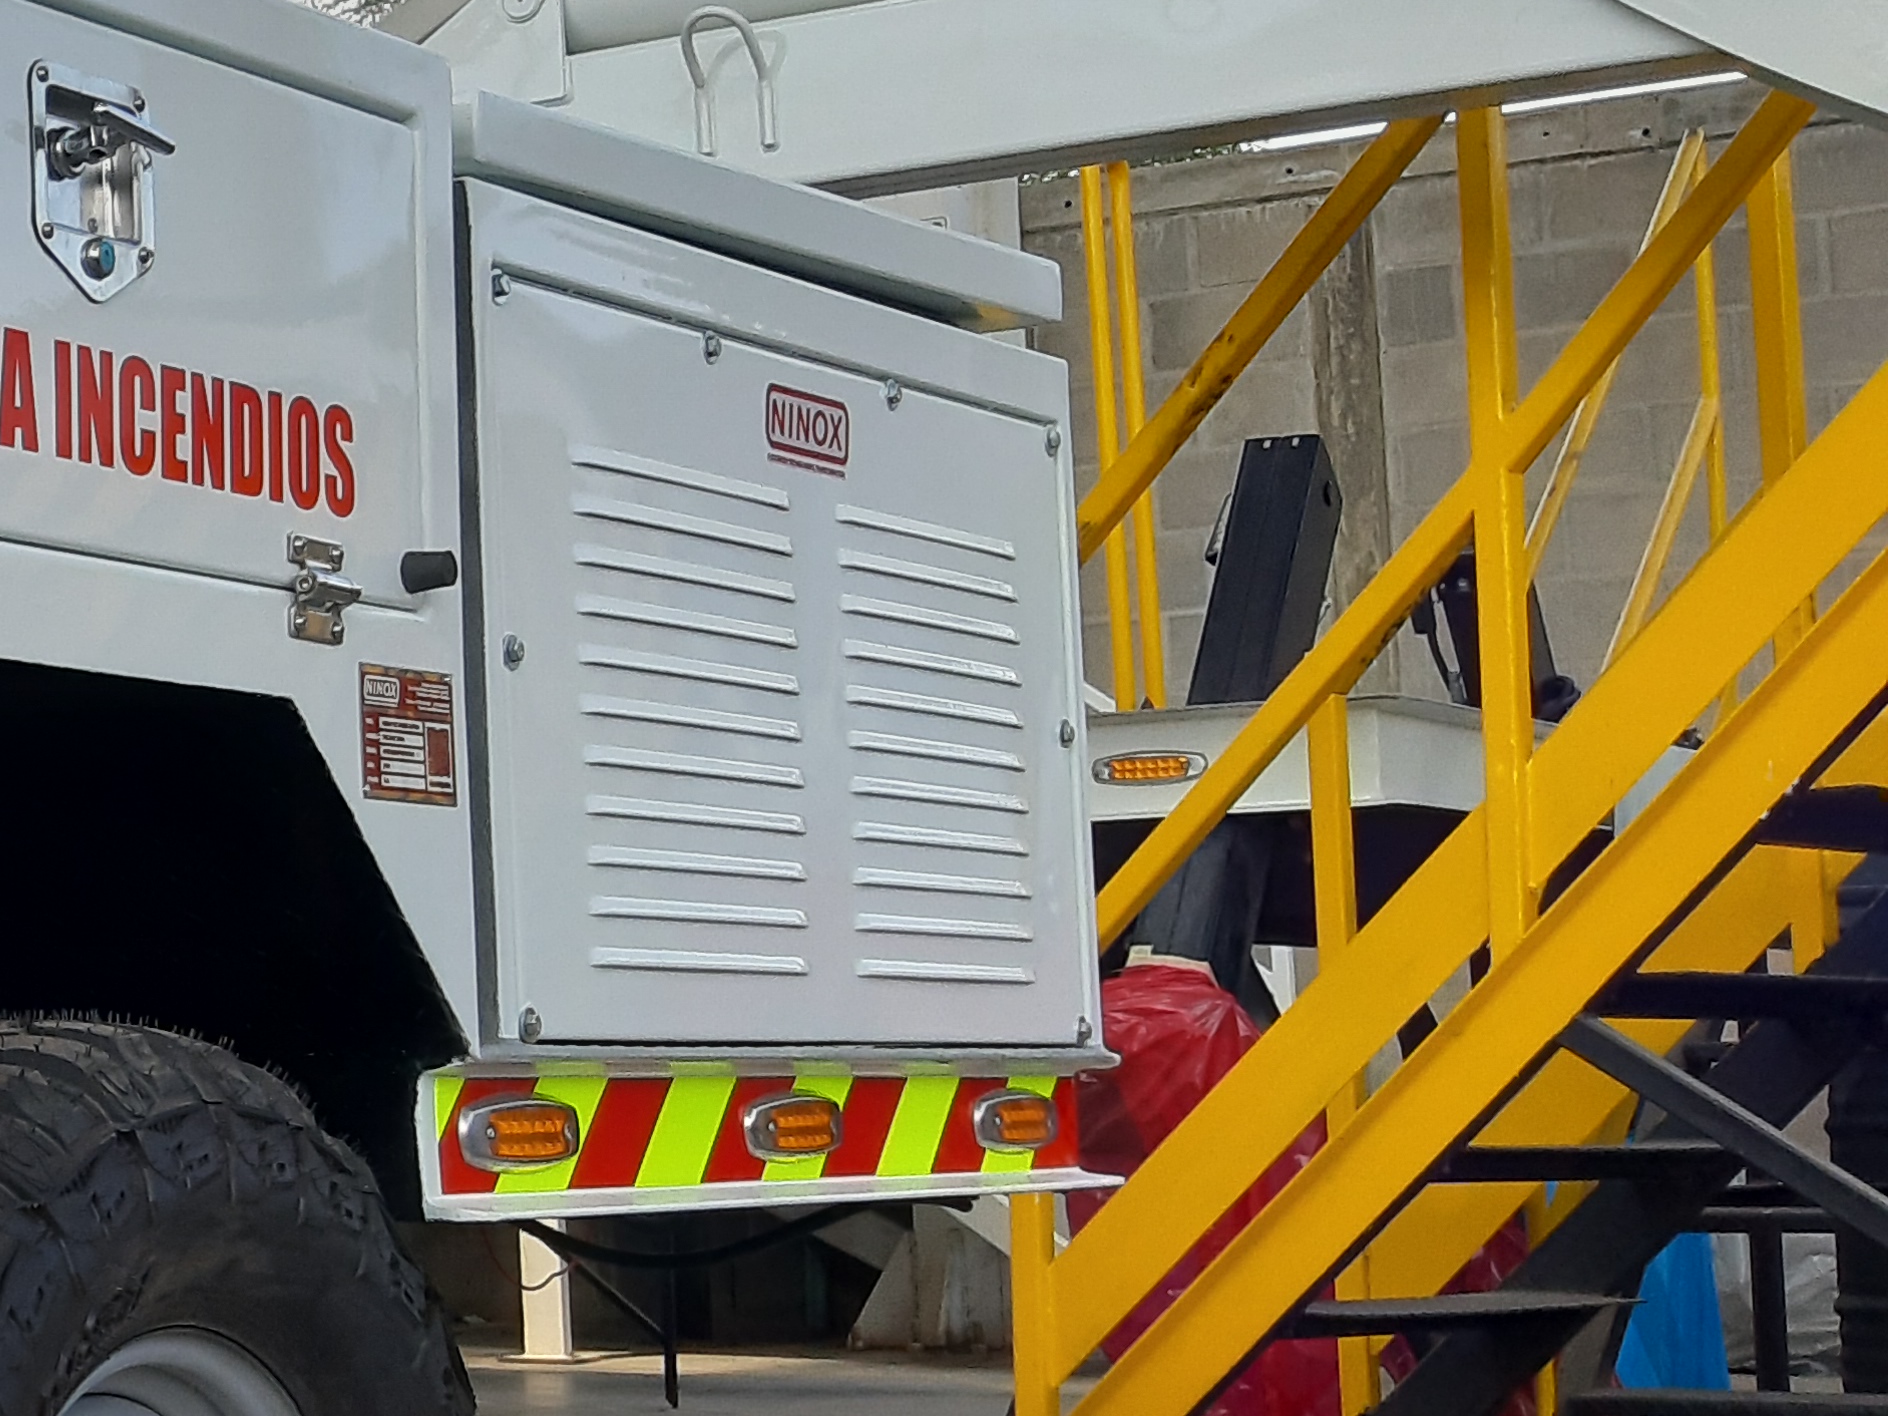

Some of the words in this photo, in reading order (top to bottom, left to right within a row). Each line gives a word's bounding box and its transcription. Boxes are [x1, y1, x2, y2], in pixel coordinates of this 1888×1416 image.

[53, 339, 358, 518] INCENDIOS
[771, 398, 843, 452] NINOX
[365, 680, 398, 699] NINOX
